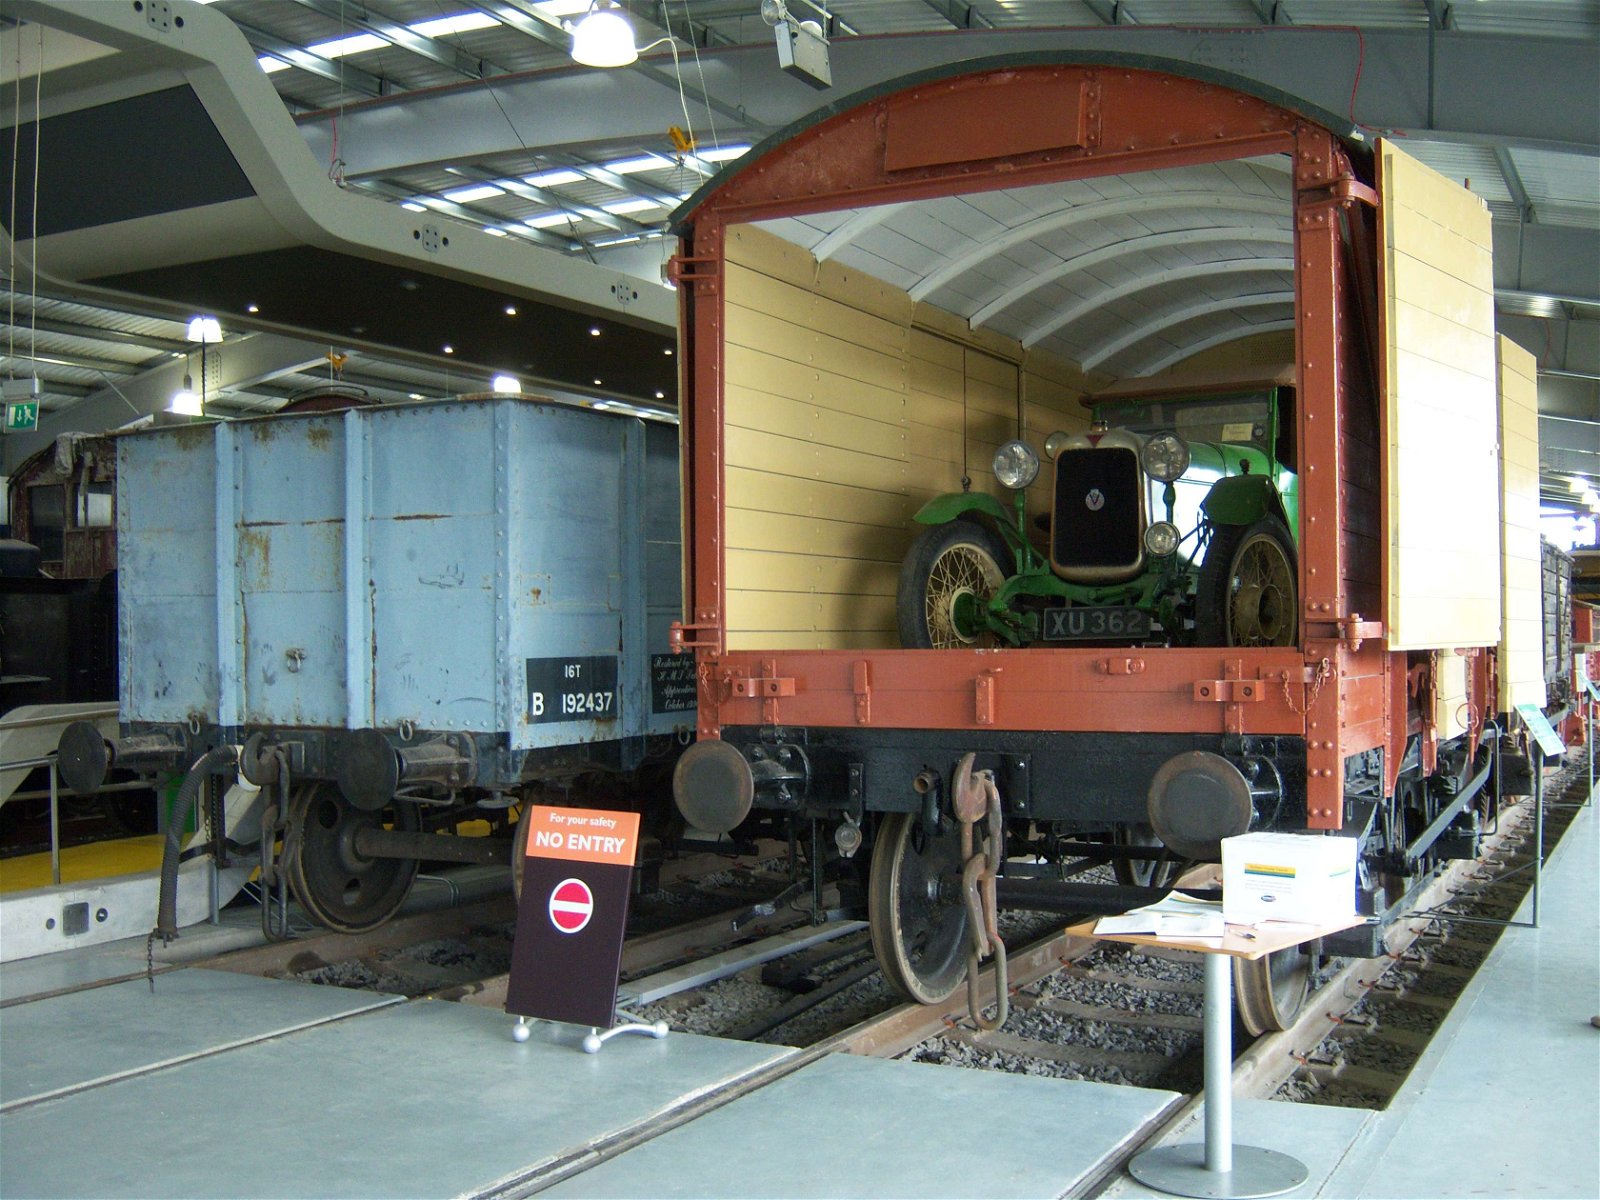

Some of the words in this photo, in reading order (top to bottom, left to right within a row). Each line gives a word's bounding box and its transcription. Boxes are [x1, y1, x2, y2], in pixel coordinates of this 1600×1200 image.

[1052, 612, 1085, 635] XU
[1091, 610, 1142, 634] 362
[565, 665, 581, 678] 16T
[532, 692, 544, 716] B
[562, 692, 613, 714] 192437
[550, 812, 565, 823] For
[567, 816, 588, 826] your
[589, 816, 616, 829] safety
[536, 831, 563, 848] NO
[567, 833, 626, 854] ENTRY
